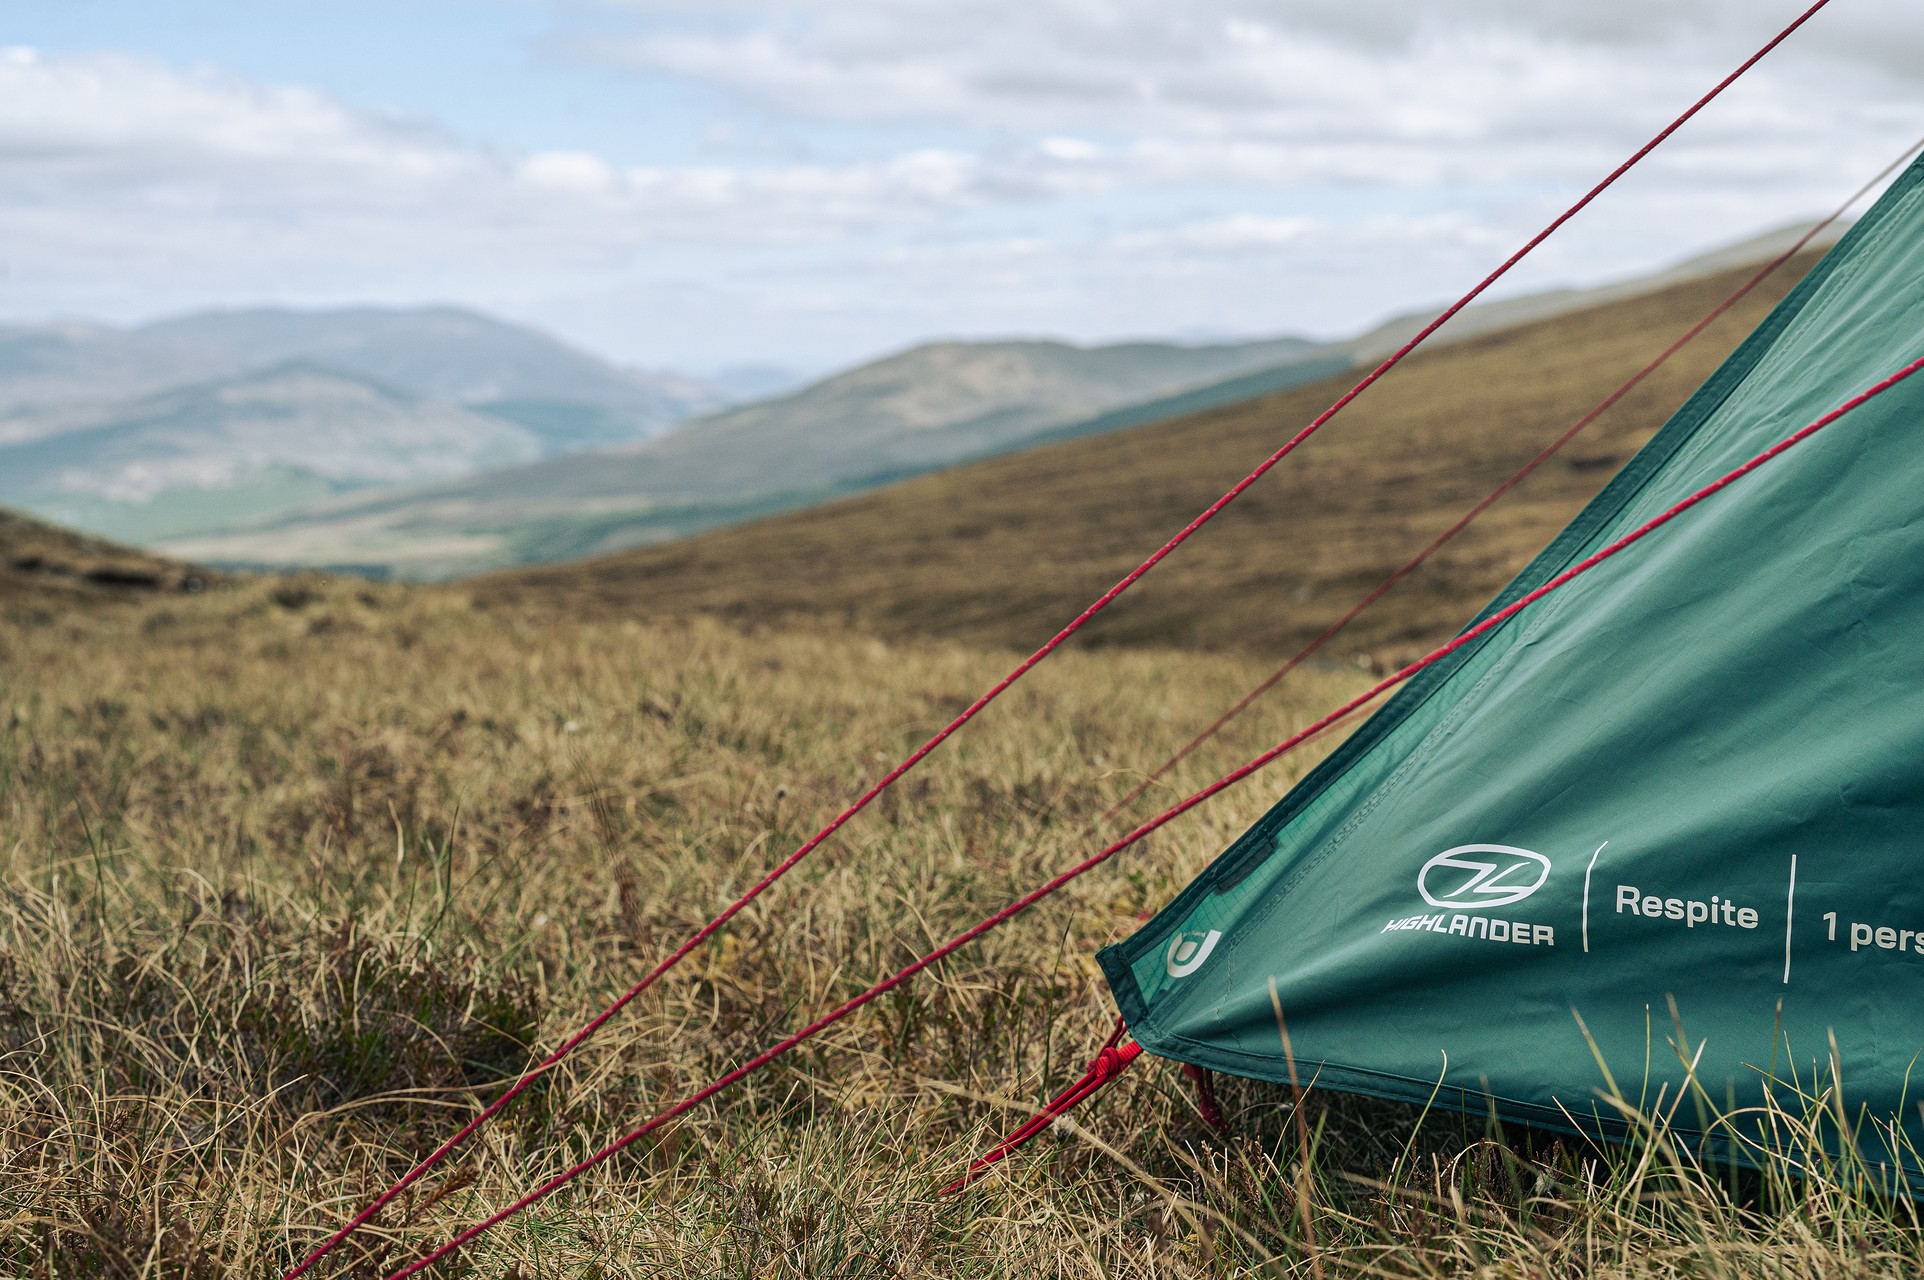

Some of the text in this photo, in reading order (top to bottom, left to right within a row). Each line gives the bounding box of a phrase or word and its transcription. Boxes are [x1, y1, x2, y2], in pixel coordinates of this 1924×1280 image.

[1616, 885, 1759, 929] Respite
[1380, 914, 1555, 946] HIGHLANDER
[1823, 911, 1837, 941] 1
